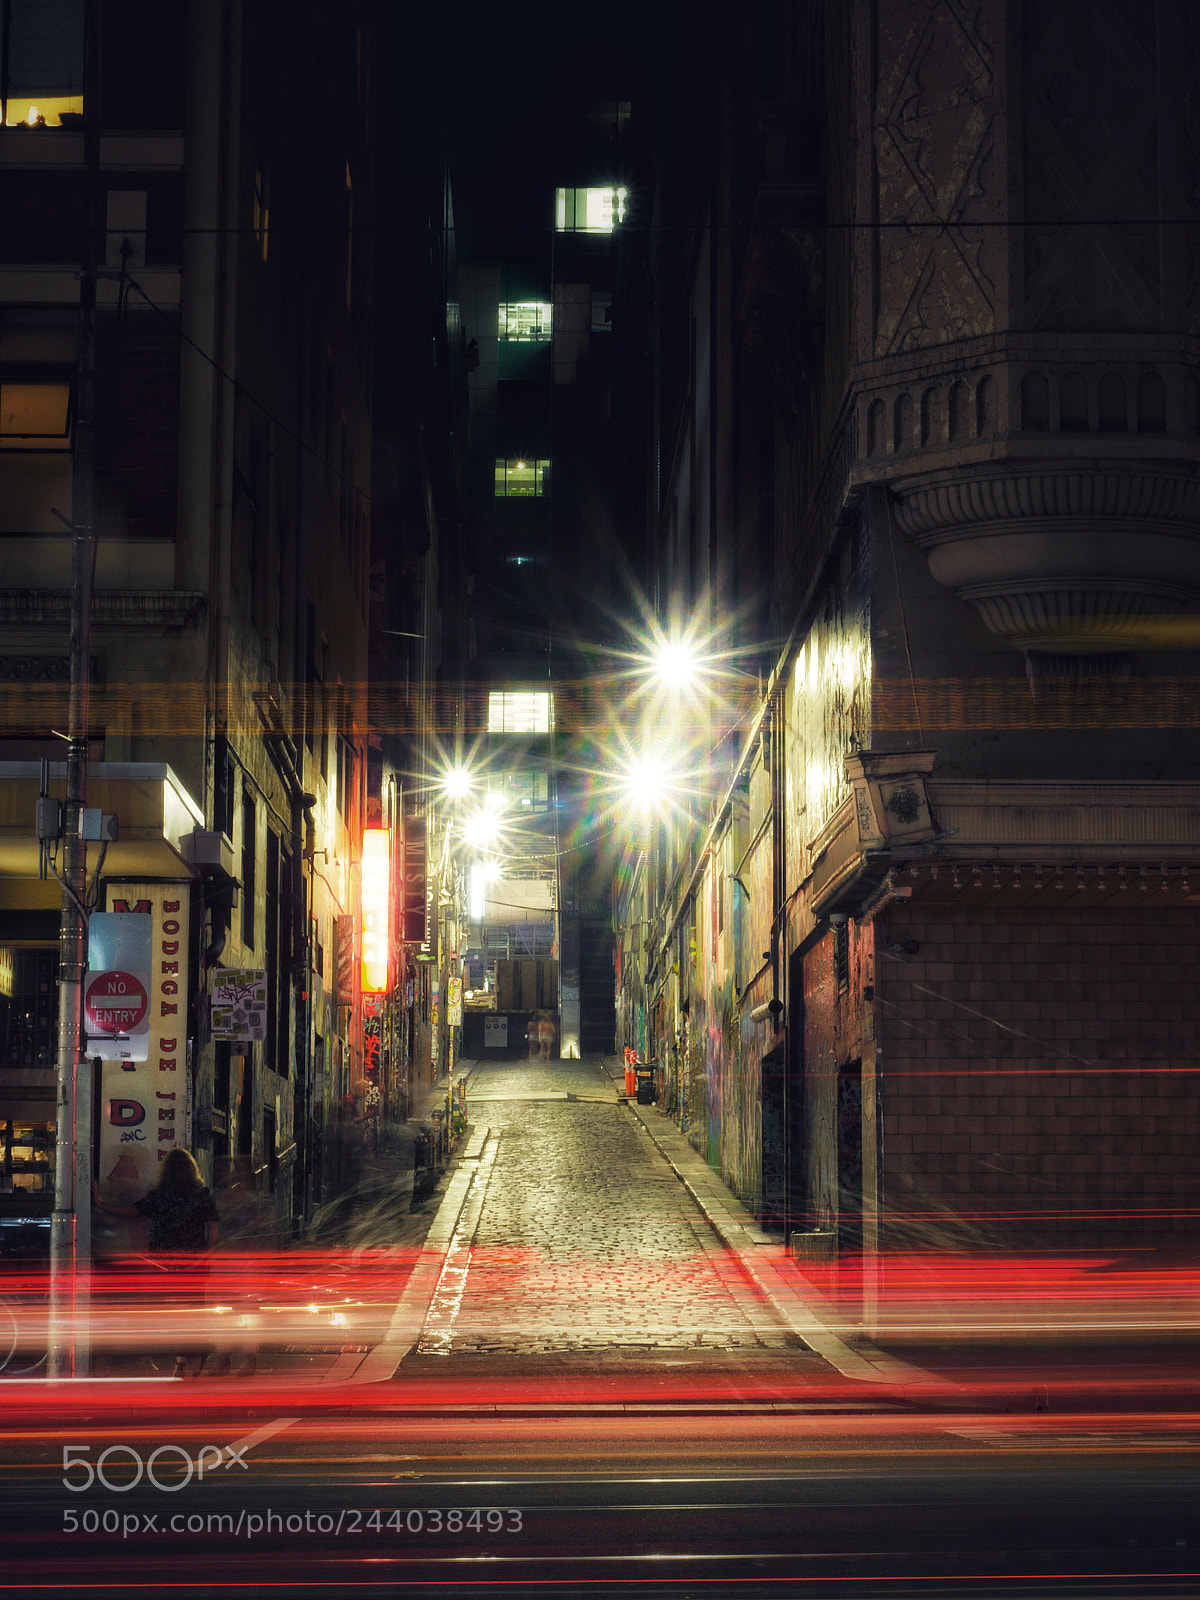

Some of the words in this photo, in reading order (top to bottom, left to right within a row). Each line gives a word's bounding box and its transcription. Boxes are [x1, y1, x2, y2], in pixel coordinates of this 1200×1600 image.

[405, 841, 425, 915] MISTY
[160, 901, 181, 1017] BODEGA
[107, 981, 127, 994] NO
[95, 1010, 138, 1022] ENTRY
[158, 1037, 178, 1072] DE
